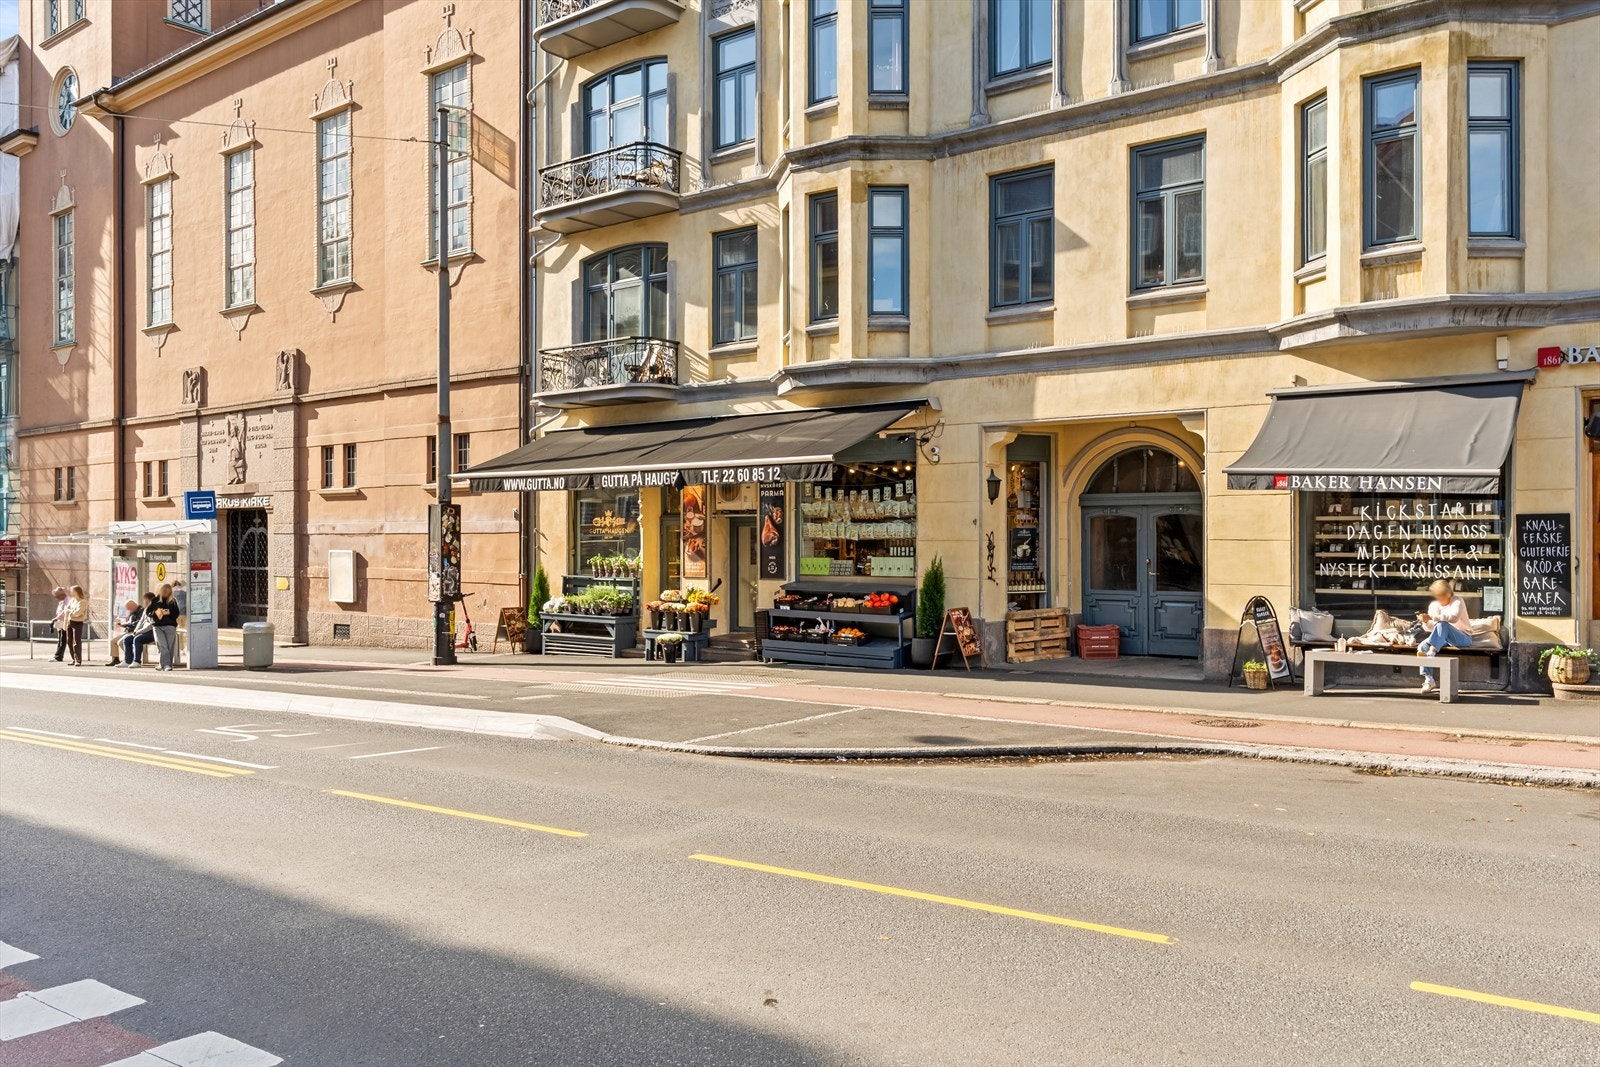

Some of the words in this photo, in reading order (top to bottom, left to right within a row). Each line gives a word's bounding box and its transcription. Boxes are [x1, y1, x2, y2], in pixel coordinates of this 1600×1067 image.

[1543, 355, 1561, 366] 1861
[601, 474, 629, 488] GUTTA
[631, 470, 643, 487] PÅ
[701, 469, 720, 483] TLF.
[722, 468, 735, 483] 22
[737, 468, 750, 482] 60
[752, 467, 765, 481] 85
[768, 466, 781, 481] 12
[503, 477, 565, 491] WWW.GUTTA.NO
[1291, 475, 1351, 490] BAKER
[1358, 475, 1443, 491] HANSEN
[760, 489, 784, 497] PARMA
[242, 496, 271, 508] KIRKE
[1347, 524, 1411, 541] DAGEN
[1420, 524, 1452, 540] HOS
[1461, 524, 1487, 539] OSS
[1523, 532, 1563, 545] FERSKE
[1357, 544, 1391, 561] MED
[1402, 544, 1458, 561] KAFFE
[1465, 544, 1482, 562] &
[1519, 543, 1570, 558] GLUTENFRIE
[115, 566, 137, 585] LYKO
[1319, 562, 1390, 579] NYSTEKT
[1552, 561, 1567, 575] &
[1521, 591, 1567, 606] VARER
